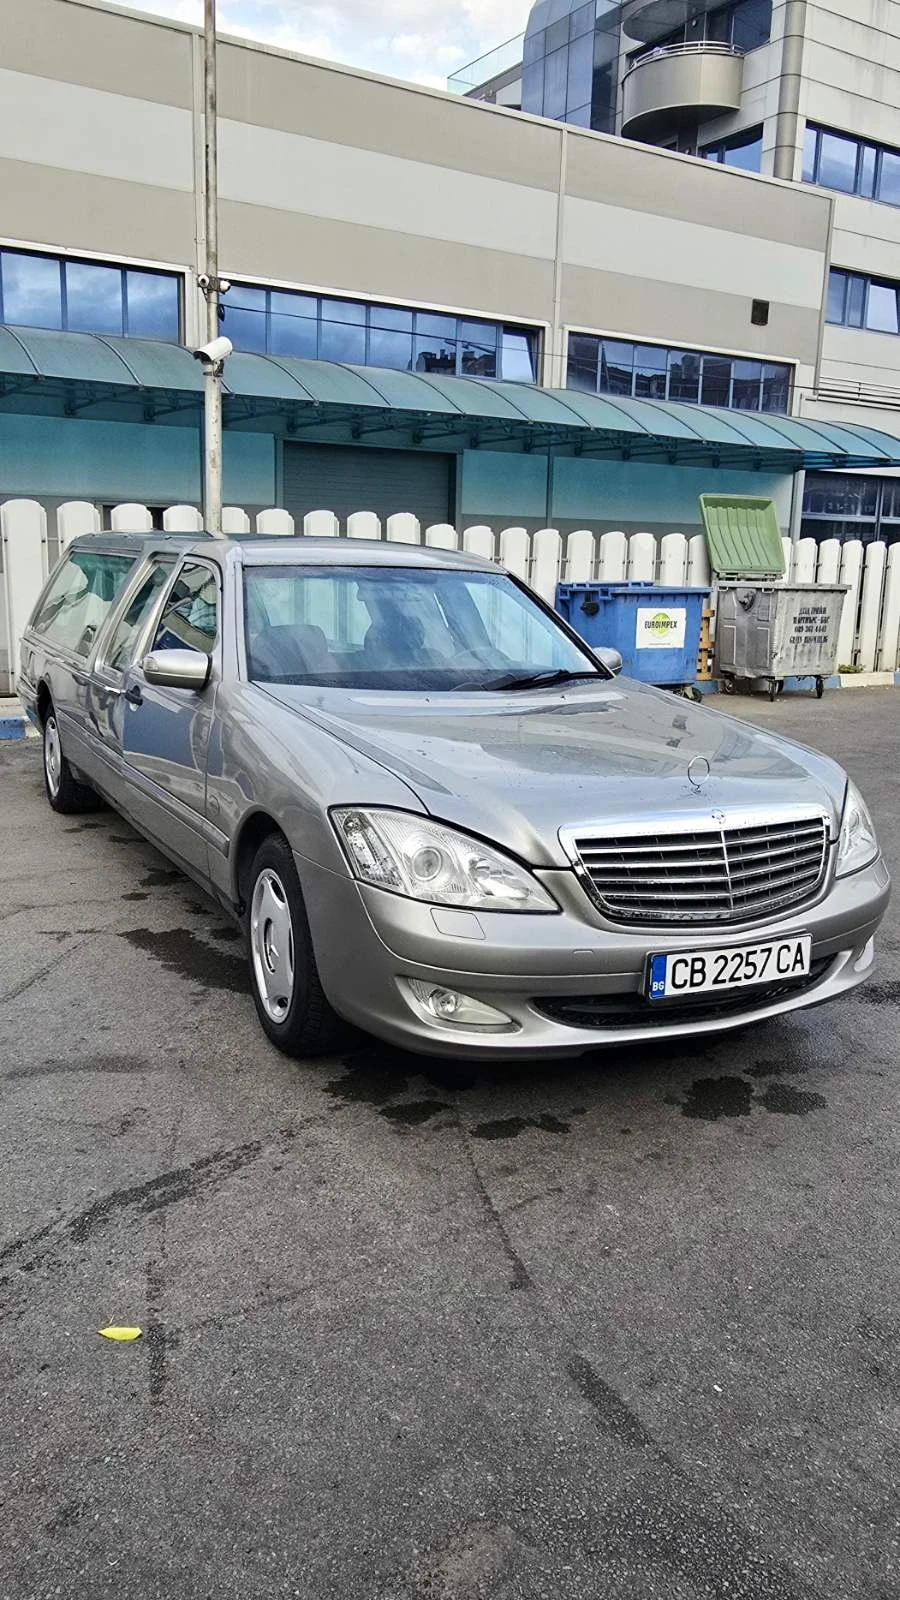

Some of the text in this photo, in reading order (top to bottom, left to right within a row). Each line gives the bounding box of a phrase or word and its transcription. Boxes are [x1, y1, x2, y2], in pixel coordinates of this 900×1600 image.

[644, 620, 678, 629] EUROIMPEX
[671, 942, 805, 989] CB 2257 CA
[652, 981, 665, 992] BG
